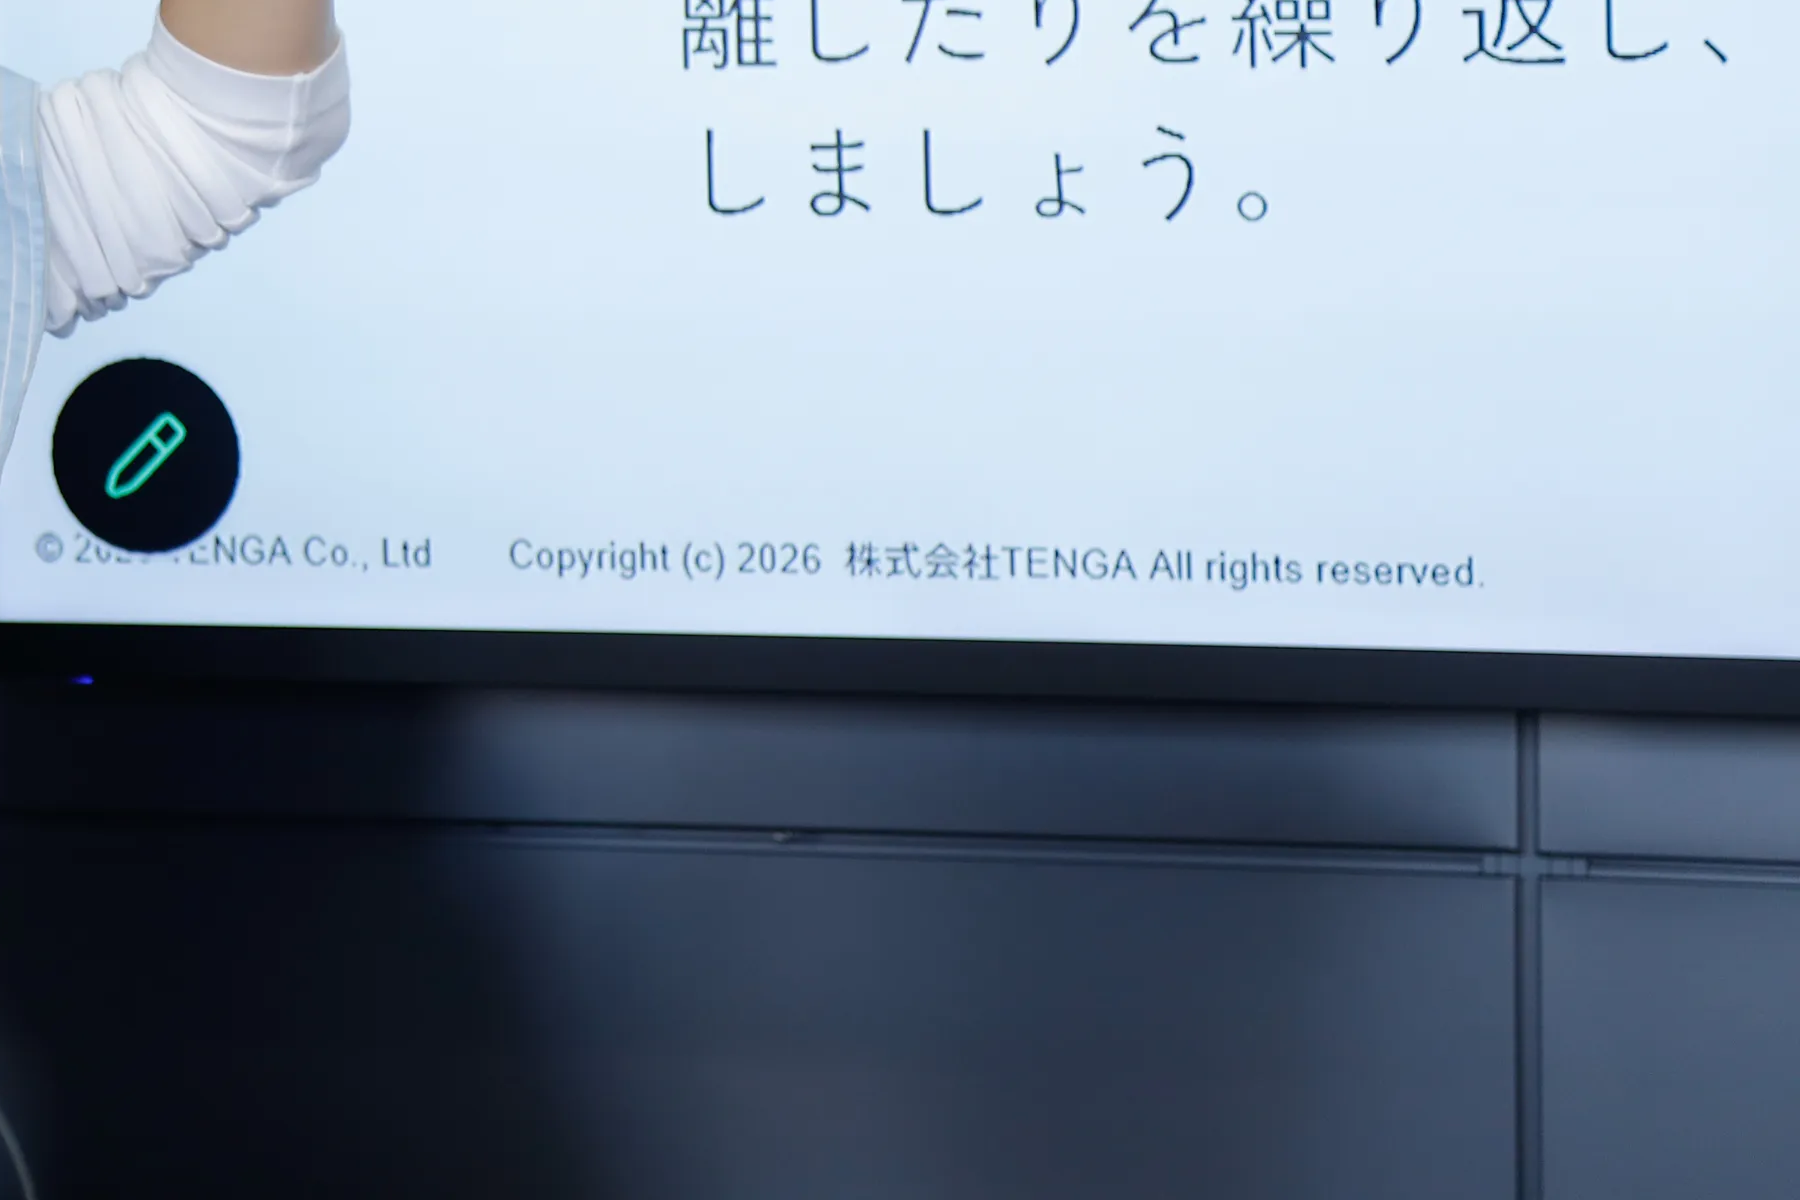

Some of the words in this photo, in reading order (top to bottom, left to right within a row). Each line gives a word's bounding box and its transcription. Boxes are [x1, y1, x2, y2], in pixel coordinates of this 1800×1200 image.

[705, 125, 1269, 222] しましょう。
[172, 535, 292, 566] ENGA
[303, 535, 368, 572] Co.,
[382, 537, 431, 568] Ltd
[509, 538, 669, 580] Copyright
[682, 542, 725, 580] (c)
[738, 542, 821, 575] 2026
[845, 541, 1137, 580] 株式会社TENGA
[1149, 549, 1192, 581] All
[1206, 550, 1303, 591] rights
[1317, 556, 1484, 588] reserved.
